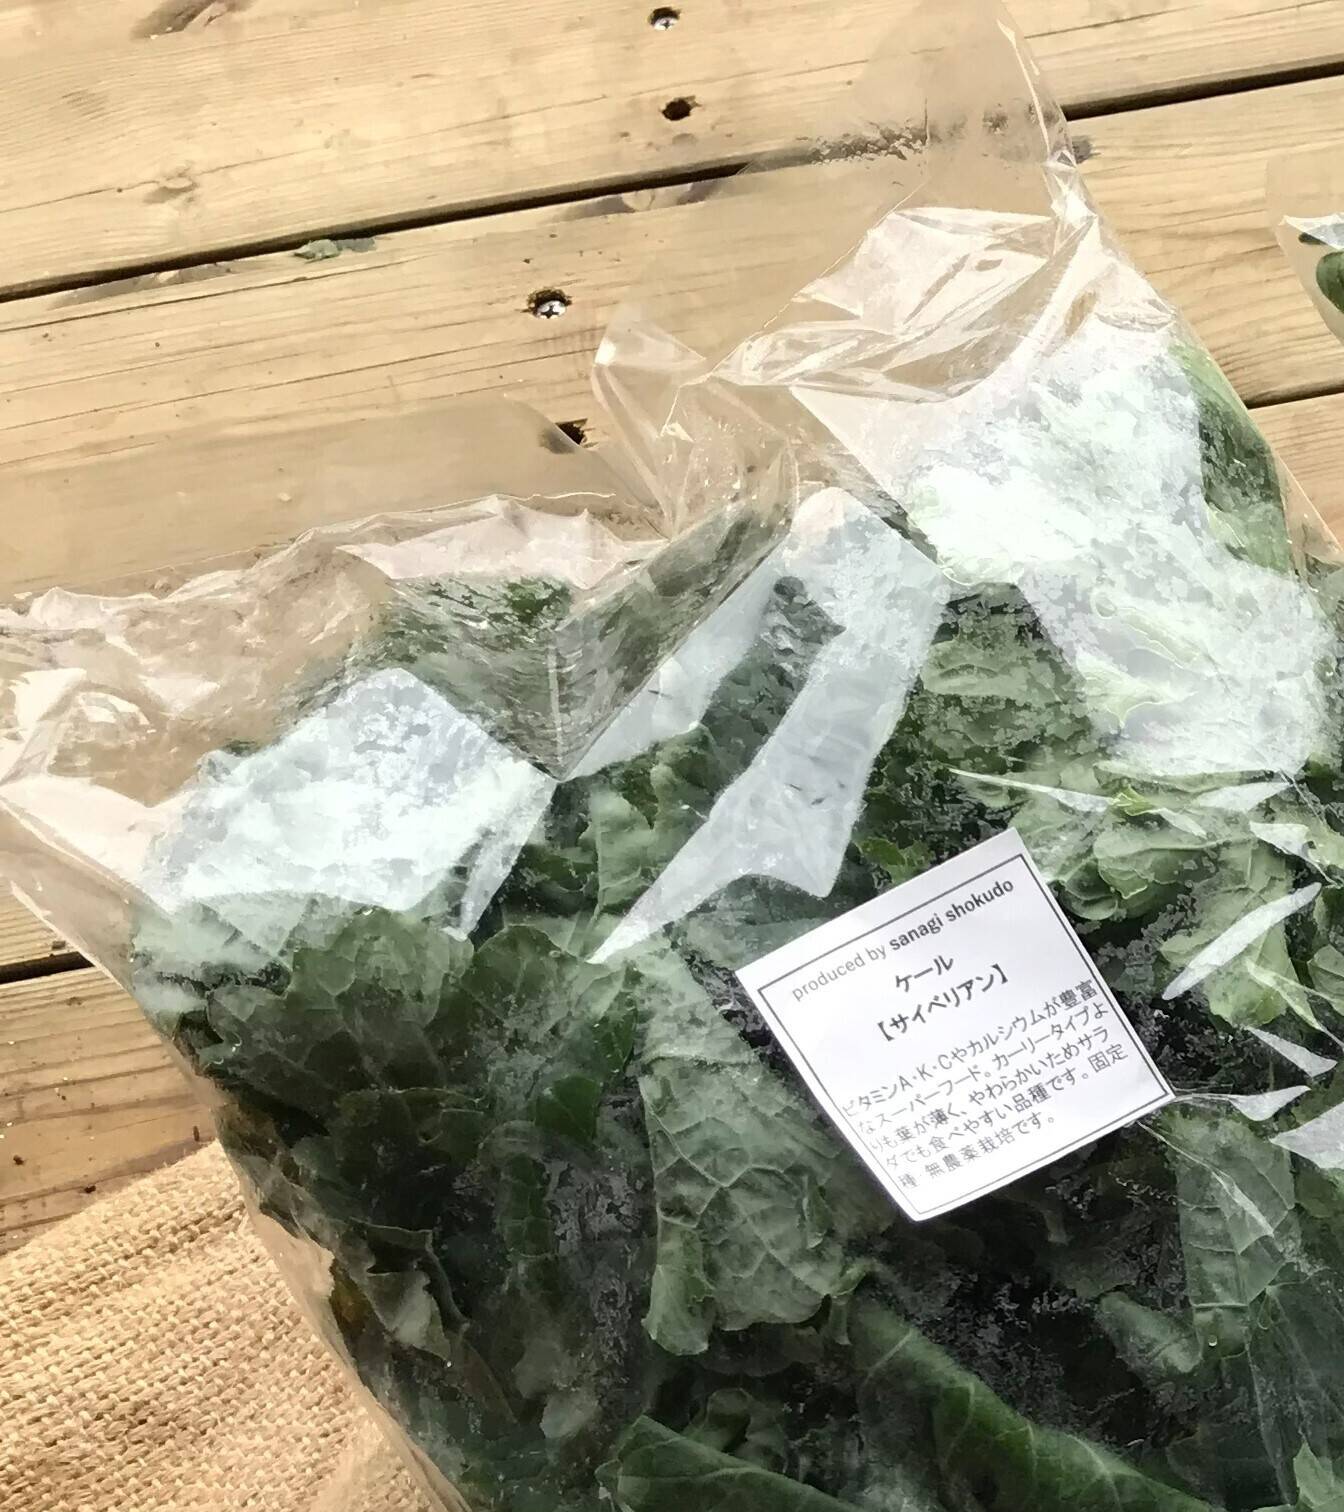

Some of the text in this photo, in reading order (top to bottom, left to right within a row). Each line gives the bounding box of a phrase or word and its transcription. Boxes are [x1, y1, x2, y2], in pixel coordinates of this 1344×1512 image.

[791, 880, 1014, 1002] produced by sanagi shokudo
[894, 954, 954, 993] ケール
[876, 962, 1008, 1042] 【サイベリアン】
